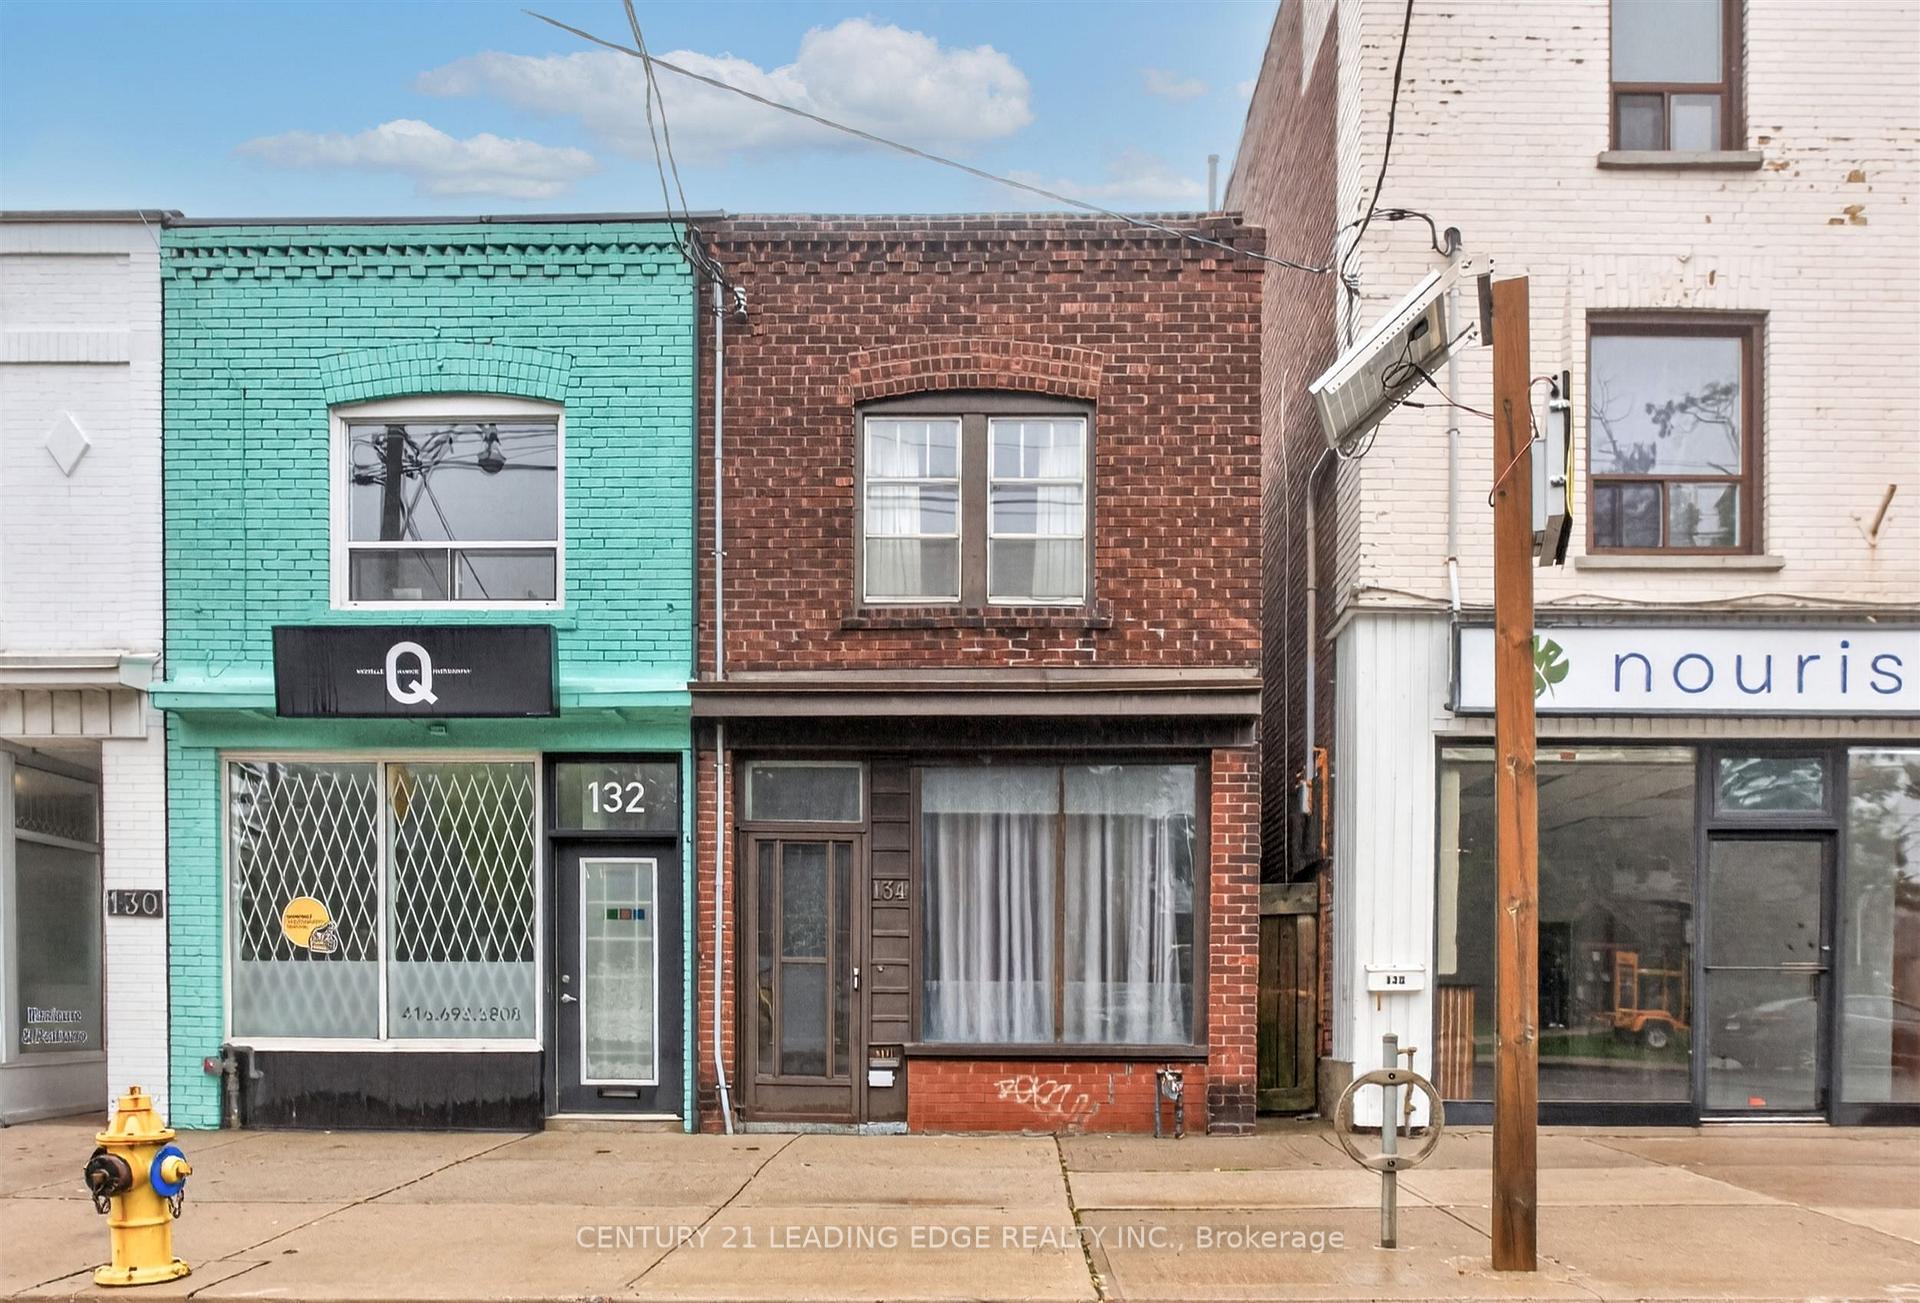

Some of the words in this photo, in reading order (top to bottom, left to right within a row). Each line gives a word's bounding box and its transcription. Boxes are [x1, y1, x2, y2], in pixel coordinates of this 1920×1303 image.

[386, 641, 439, 705] Q
[1614, 640, 1904, 695] nouris
[588, 781, 645, 813] 132
[110, 891, 158, 915] 130
[873, 880, 905, 900] 134
